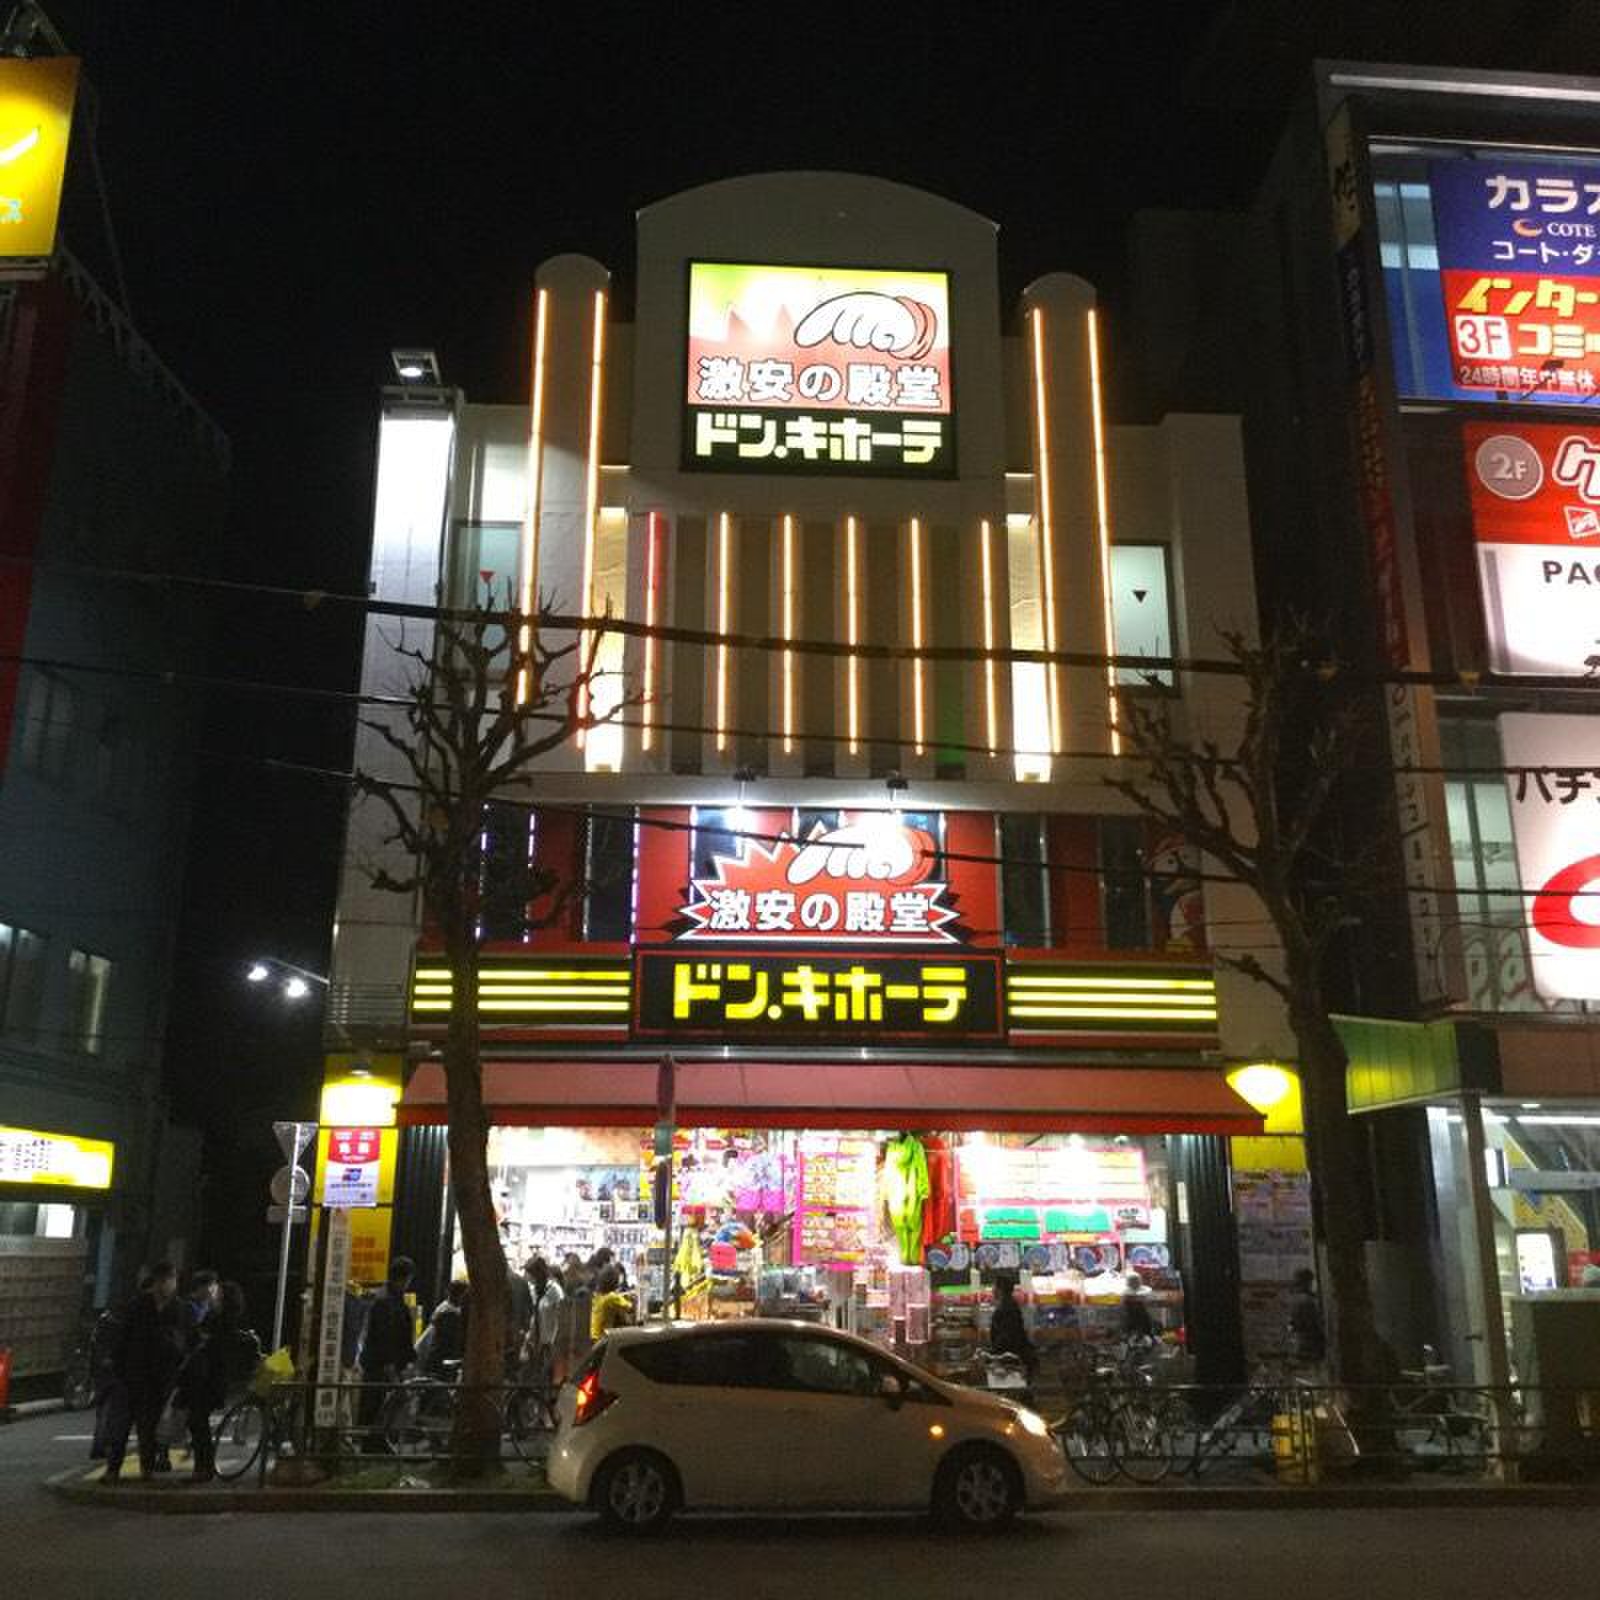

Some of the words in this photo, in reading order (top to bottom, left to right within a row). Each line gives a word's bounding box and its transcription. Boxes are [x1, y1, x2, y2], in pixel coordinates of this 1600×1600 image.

[1546, 222, 1597, 238] COTE
[1492, 241, 1600, 265] コート・ダ
[1459, 319, 1503, 355] 3F
[697, 355, 942, 407] 激安の殿堂
[1490, 452, 1528, 481] 2F
[1516, 765, 1600, 804] パチ
[708, 889, 933, 932] 激安の殿堂
